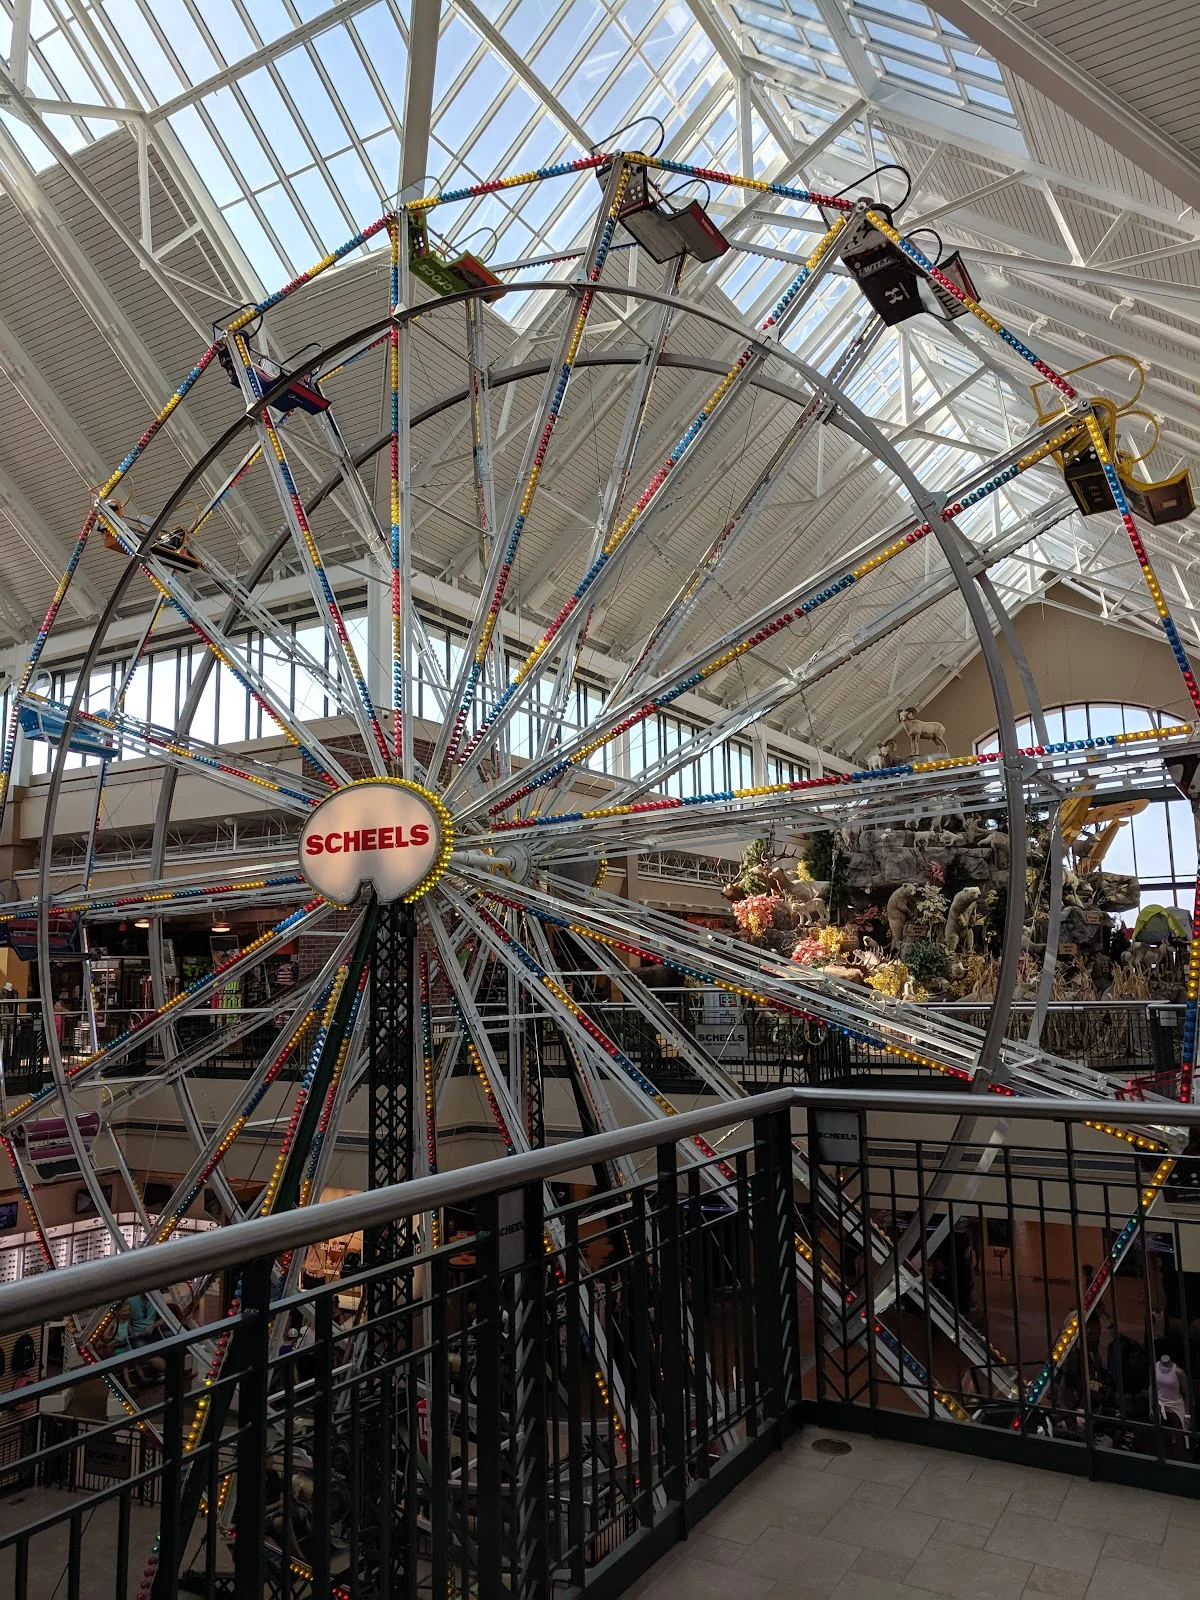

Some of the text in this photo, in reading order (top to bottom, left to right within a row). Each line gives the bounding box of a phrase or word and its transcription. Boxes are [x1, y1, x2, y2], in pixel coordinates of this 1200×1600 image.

[418, 264, 454, 291] crocs
[305, 824, 430, 856] SCHEELS
[698, 1034, 745, 1042] SCHEELS
[816, 1131, 858, 1141] SCHEELS
